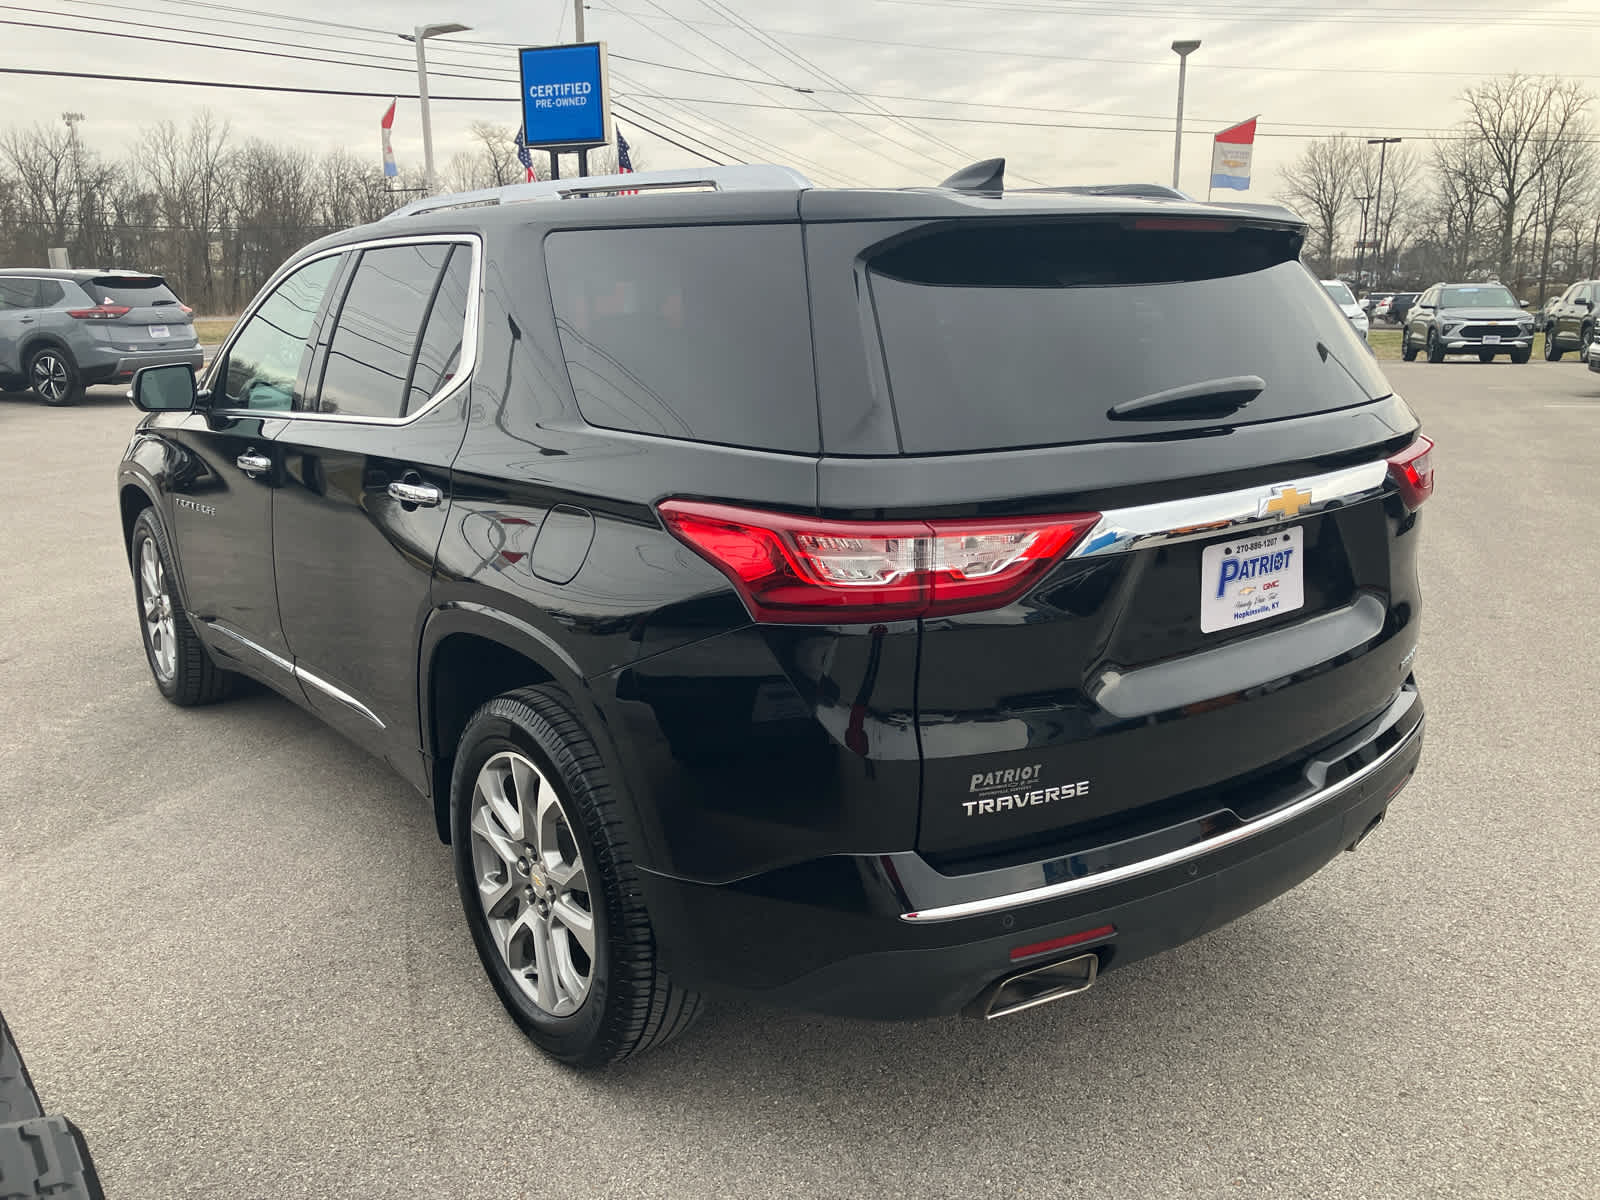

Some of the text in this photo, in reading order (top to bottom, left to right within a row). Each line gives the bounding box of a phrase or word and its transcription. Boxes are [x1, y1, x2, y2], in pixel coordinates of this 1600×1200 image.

[529, 82, 591, 98] CERTIFIED
[535, 96, 587, 109] PRE-OWNED
[1216, 549, 1293, 599] PATRIOT
[1263, 580, 1280, 591] GMC
[1271, 601, 1280, 609] KY
[971, 764, 1041, 792] PATRIOT
[962, 780, 1090, 816] TRAVERSE
